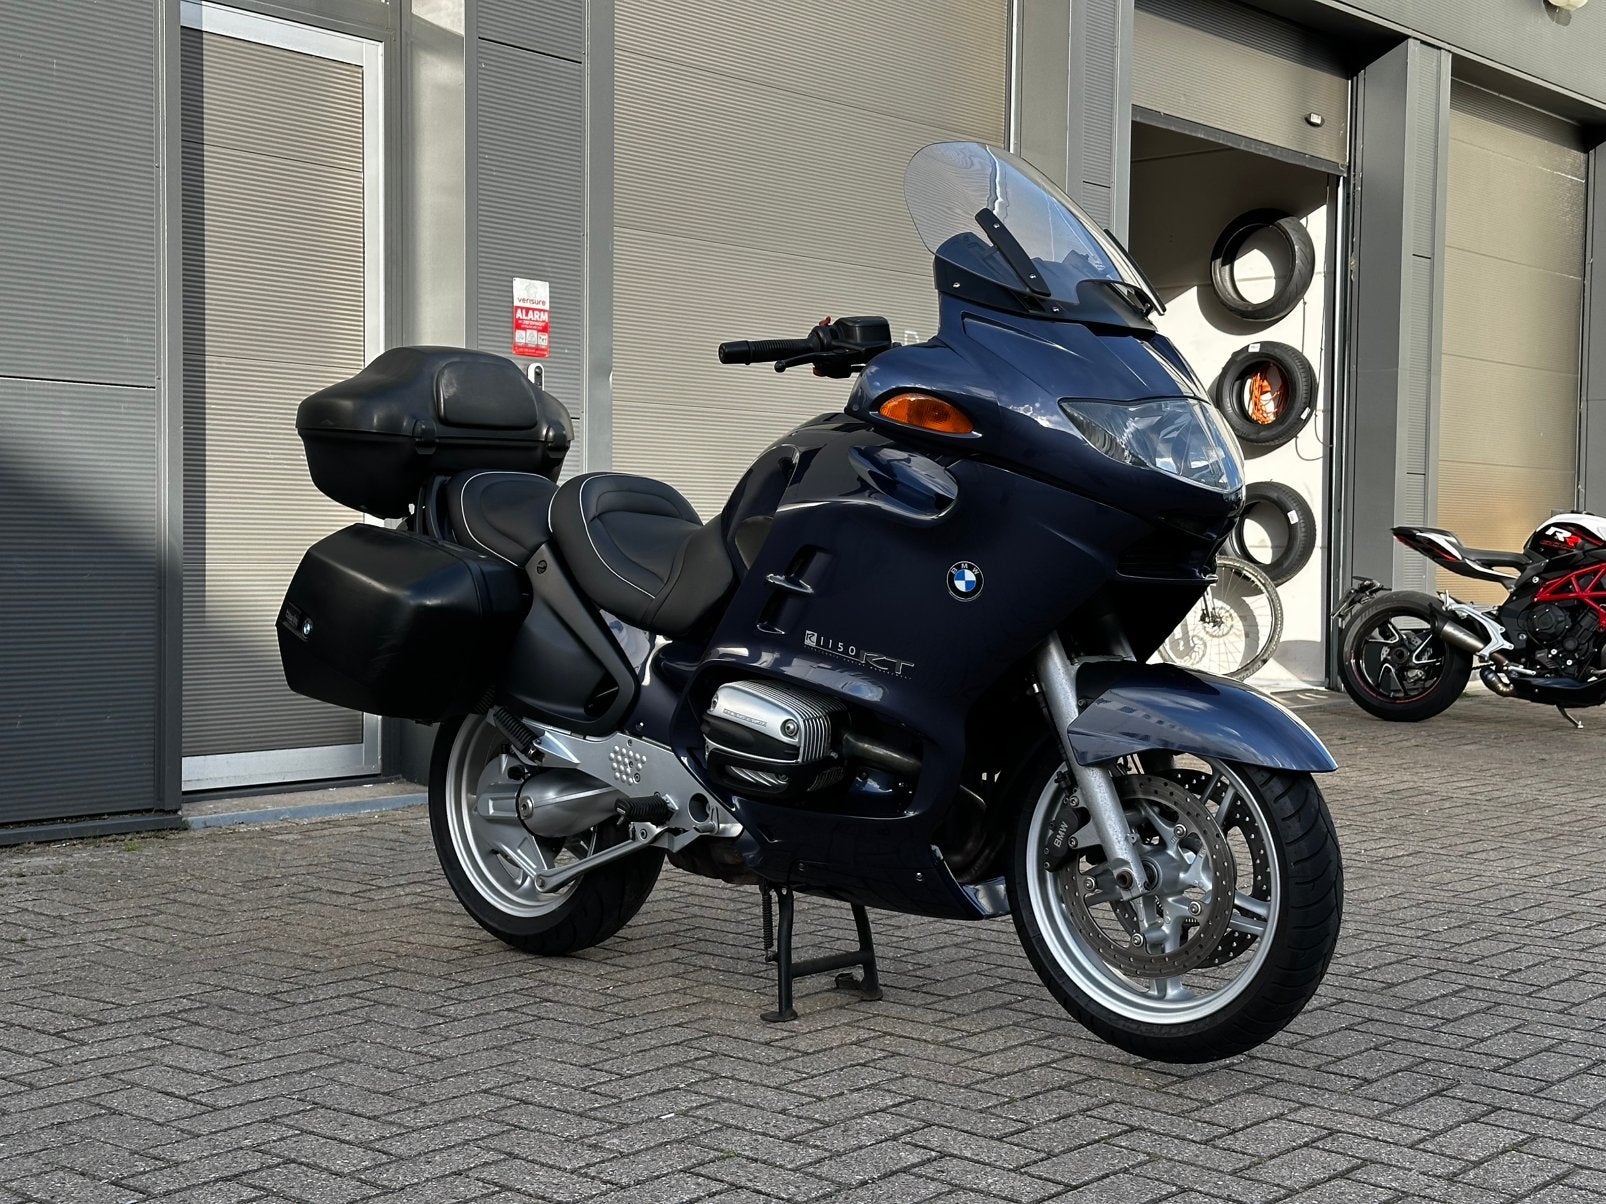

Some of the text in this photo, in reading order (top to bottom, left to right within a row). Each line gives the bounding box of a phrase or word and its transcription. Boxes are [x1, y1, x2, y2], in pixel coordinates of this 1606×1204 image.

[517, 296, 547, 307] verisure
[515, 308, 549, 322] ALARM
[1053, 821, 1069, 848] BMW
